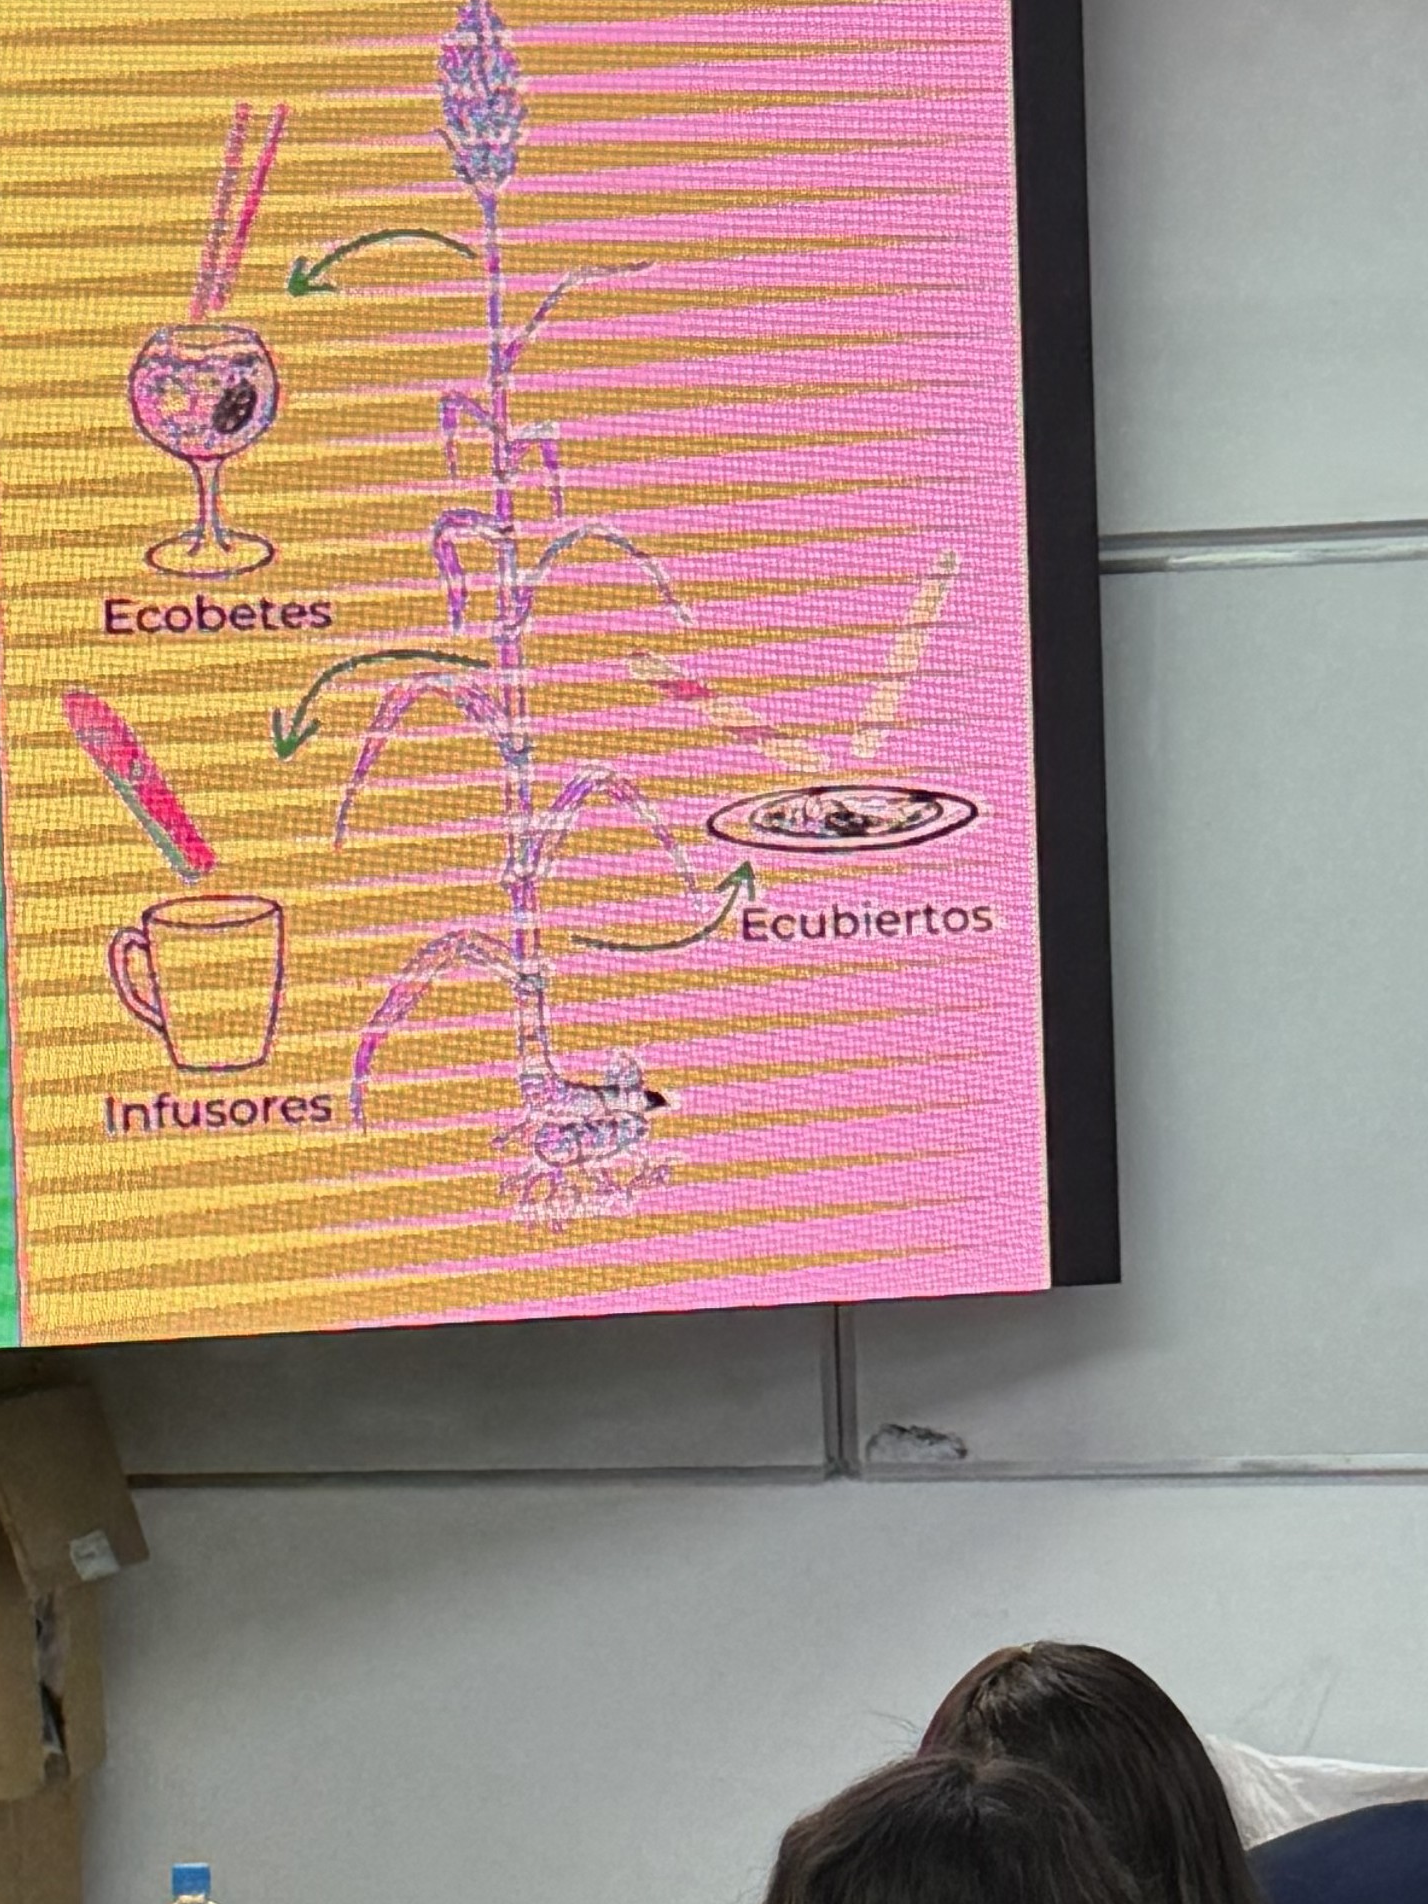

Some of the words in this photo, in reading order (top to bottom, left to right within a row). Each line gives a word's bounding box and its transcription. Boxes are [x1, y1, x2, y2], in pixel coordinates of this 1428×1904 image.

[104, 593, 333, 635] Ecobetes
[742, 900, 993, 942] Ecubiertos
[105, 1091, 332, 1134] Infusores
